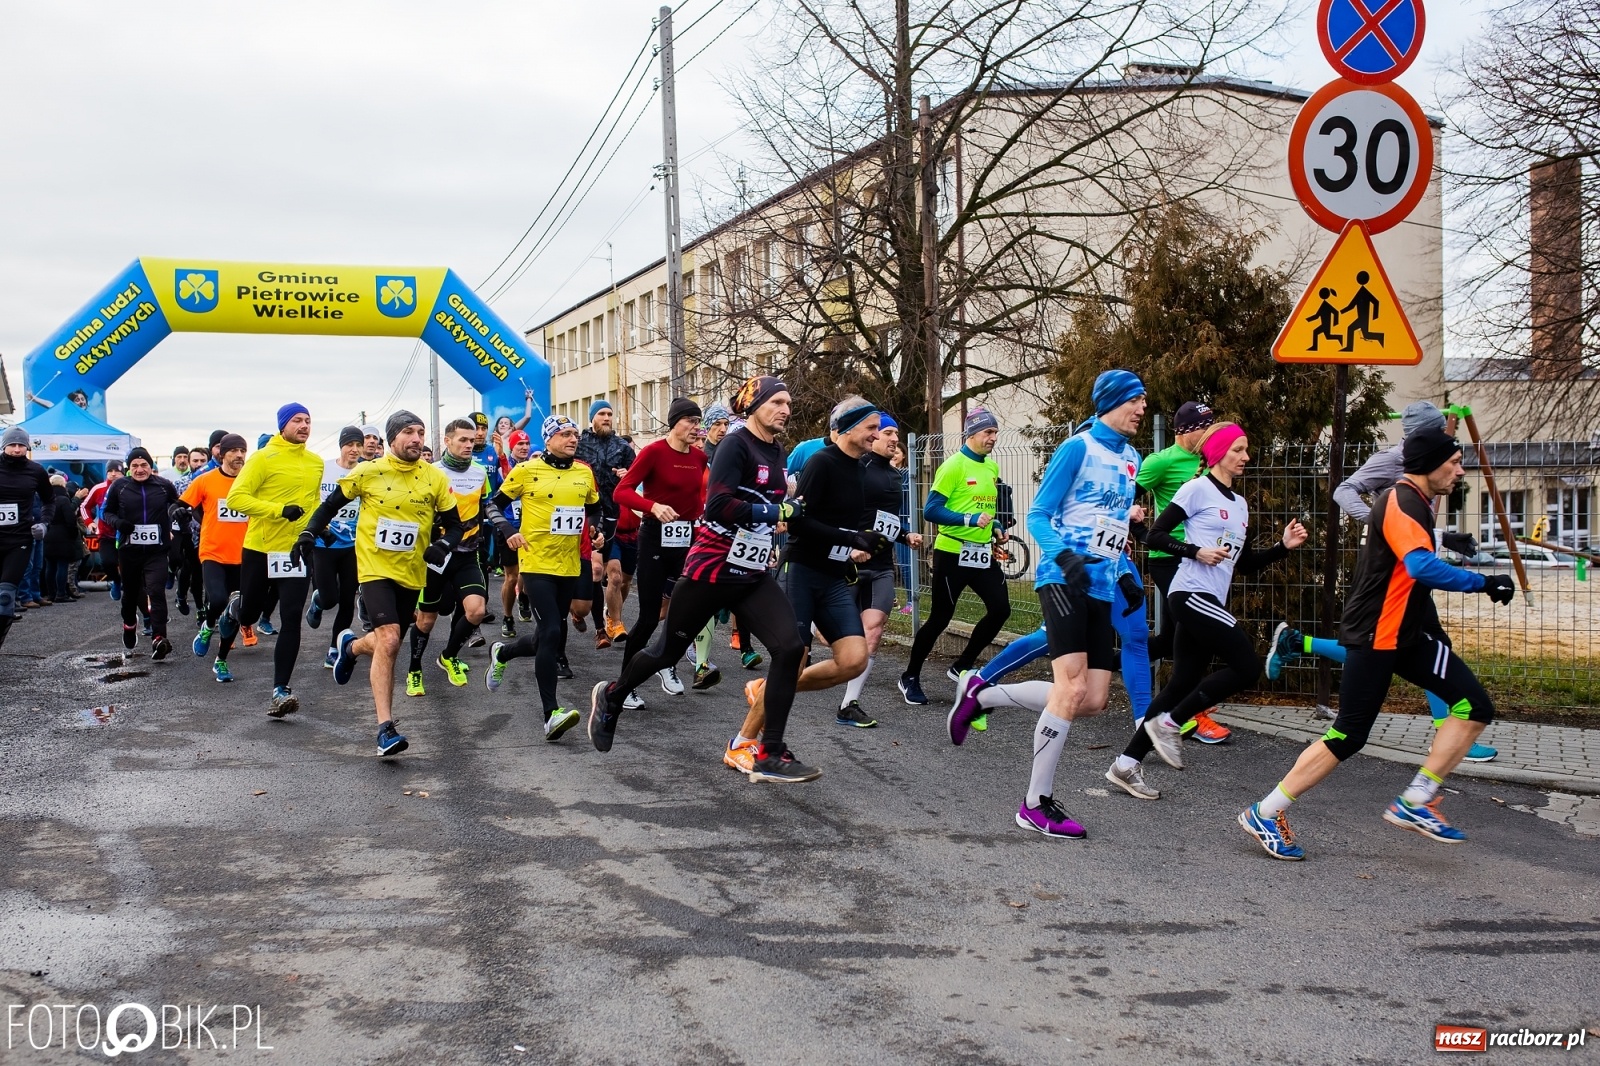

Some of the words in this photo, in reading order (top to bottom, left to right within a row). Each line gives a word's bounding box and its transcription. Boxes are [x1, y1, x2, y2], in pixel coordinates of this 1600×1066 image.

[1313, 115, 1411, 195] 30
[257, 271, 339, 285] Gmina
[236, 285, 360, 303] Pietrowice
[252, 304, 344, 320] Wielkie
[54, 316, 105, 361] Gmina
[99, 281, 143, 321] ludzi
[74, 301, 157, 375] aktywnych
[447, 292, 491, 338] Gmina
[488, 332, 527, 370] ludzi
[434, 311, 510, 382] aktywnych
[554, 516, 583, 530] 112
[664, 525, 690, 538] 258
[876, 520, 899, 537] 317
[132, 531, 157, 541] 366
[379, 529, 414, 546] 130
[1096, 530, 1125, 553] 144
[732, 542, 768, 563] 326
[961, 550, 989, 564] 246
